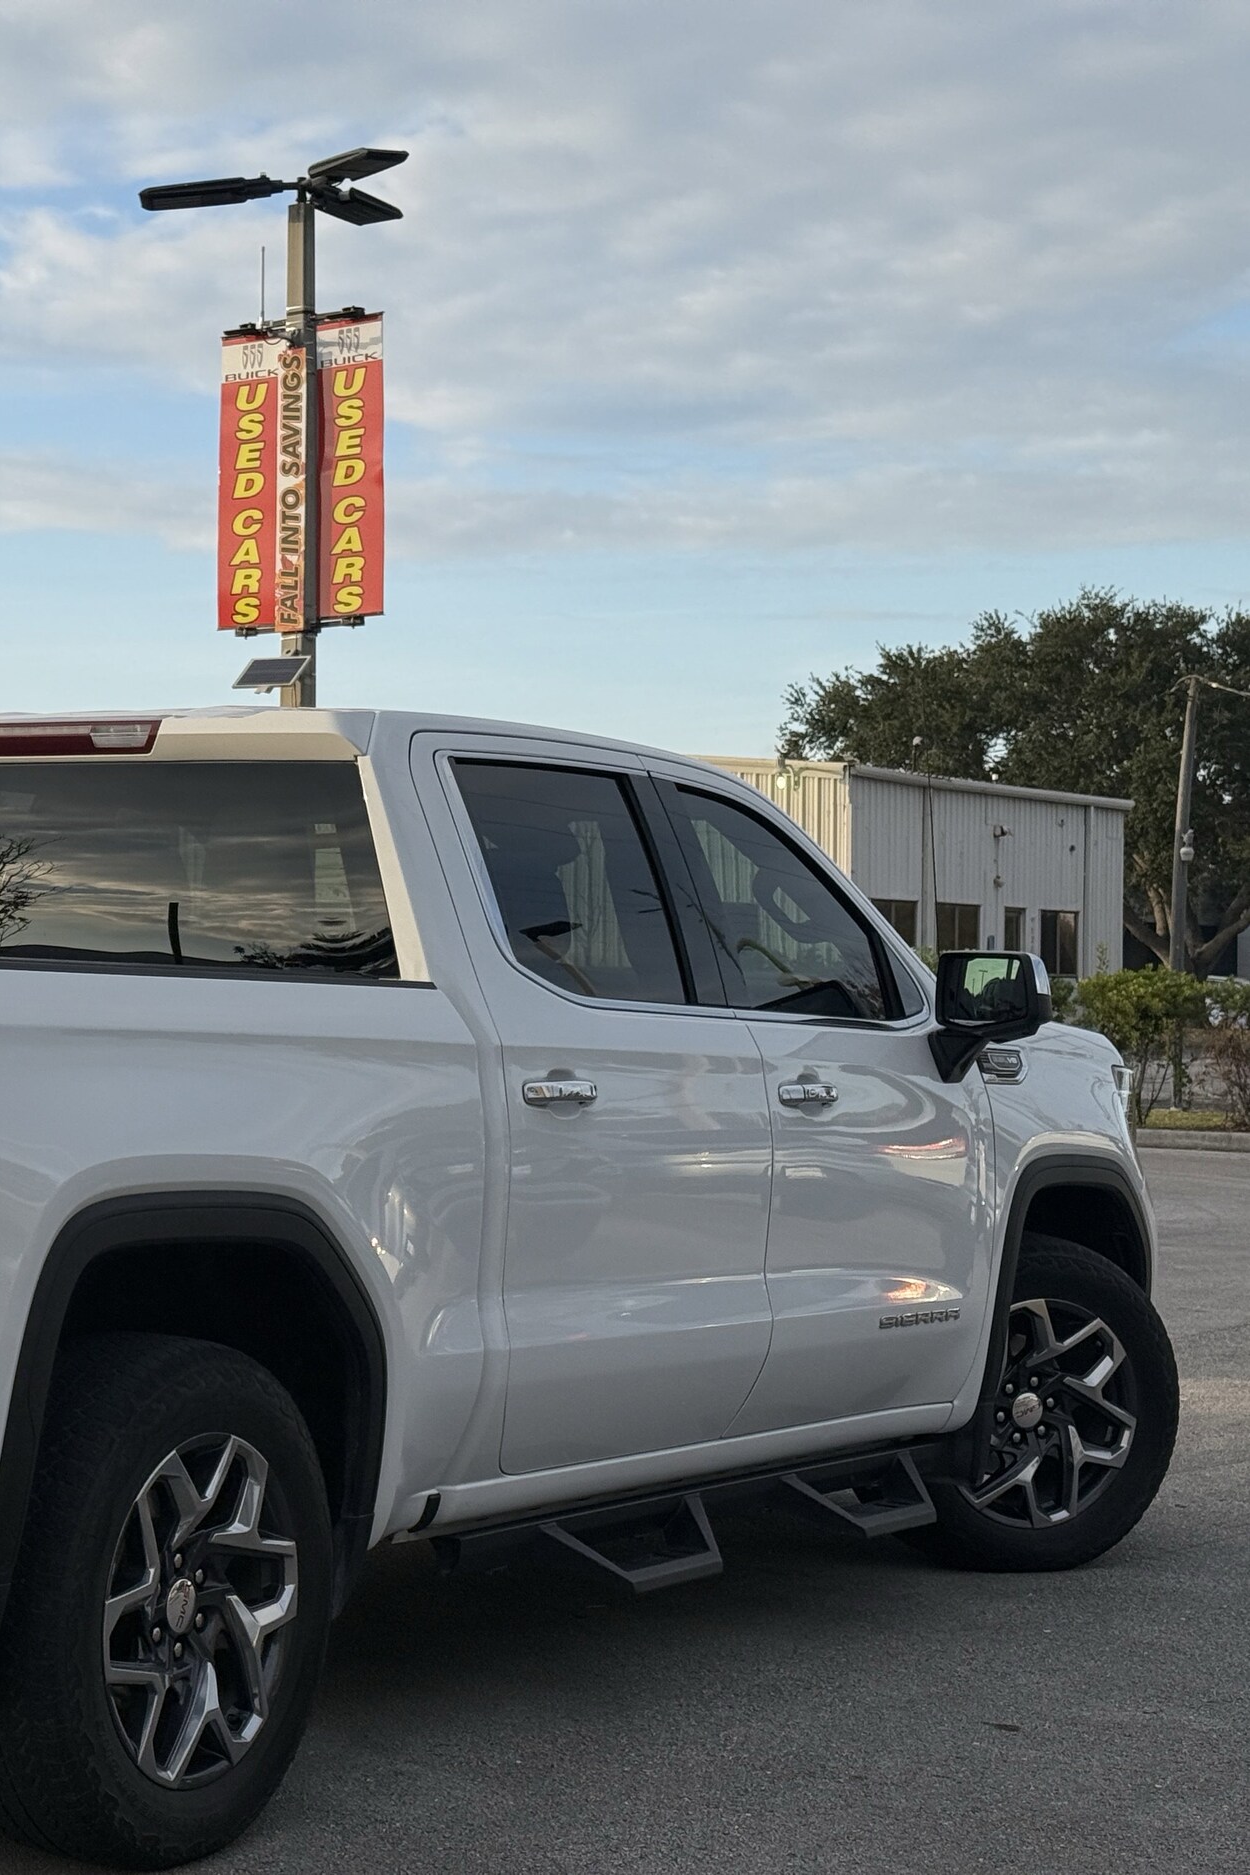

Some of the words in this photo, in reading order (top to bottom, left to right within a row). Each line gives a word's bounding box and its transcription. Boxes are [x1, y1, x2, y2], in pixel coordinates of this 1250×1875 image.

[225, 368, 280, 382] BUICK
[320, 351, 378, 368] BUICK
[232, 383, 269, 500] USED
[280, 354, 303, 478] SAVINGS
[332, 366, 368, 488] USED
[229, 508, 265, 624] CARS
[280, 488, 301, 555] INTO
[331, 495, 368, 614] CARS
[280, 564, 300, 625] FALL
[878, 1307, 961, 1329] SIERRA
